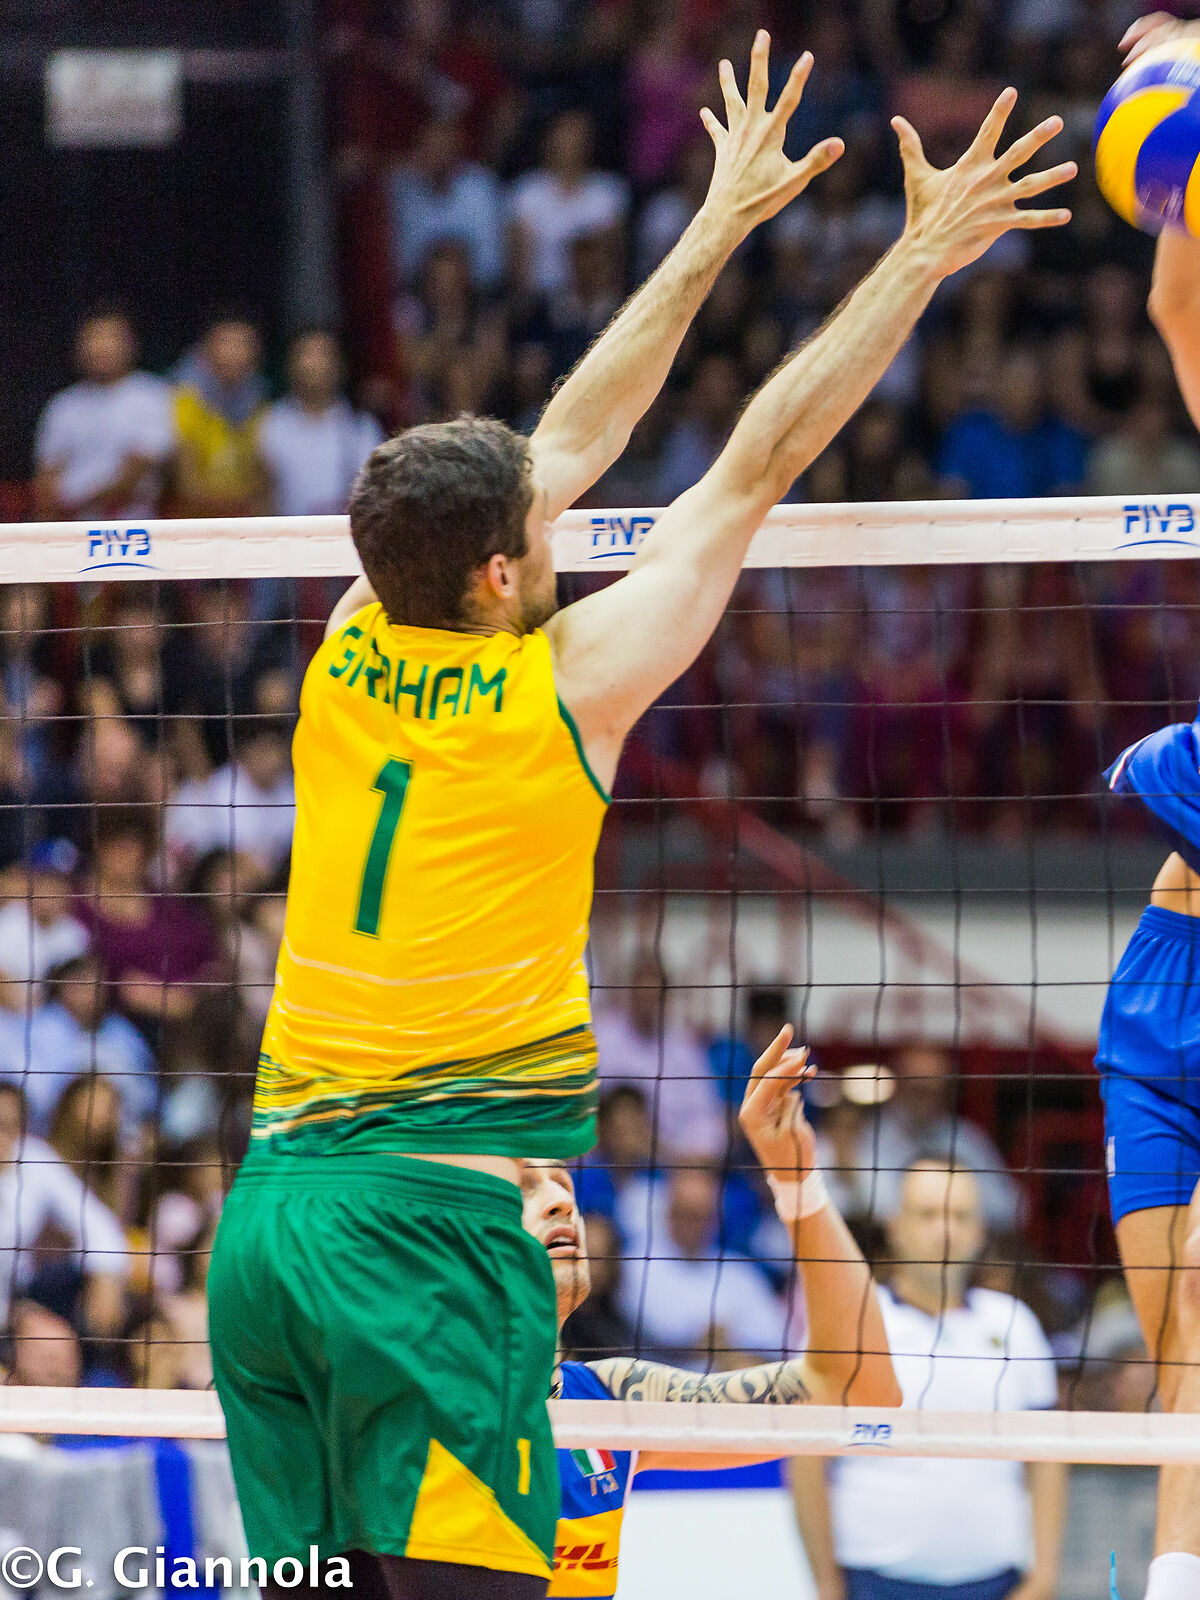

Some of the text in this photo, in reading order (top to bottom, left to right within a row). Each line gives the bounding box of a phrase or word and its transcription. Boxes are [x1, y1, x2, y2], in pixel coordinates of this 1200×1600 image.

[1122, 504, 1195, 533] FIVB
[87, 528, 152, 557] FIVB
[351, 753, 416, 941] 1
[516, 1437, 532, 1496] 1
[553, 1542, 610, 1570] HL
